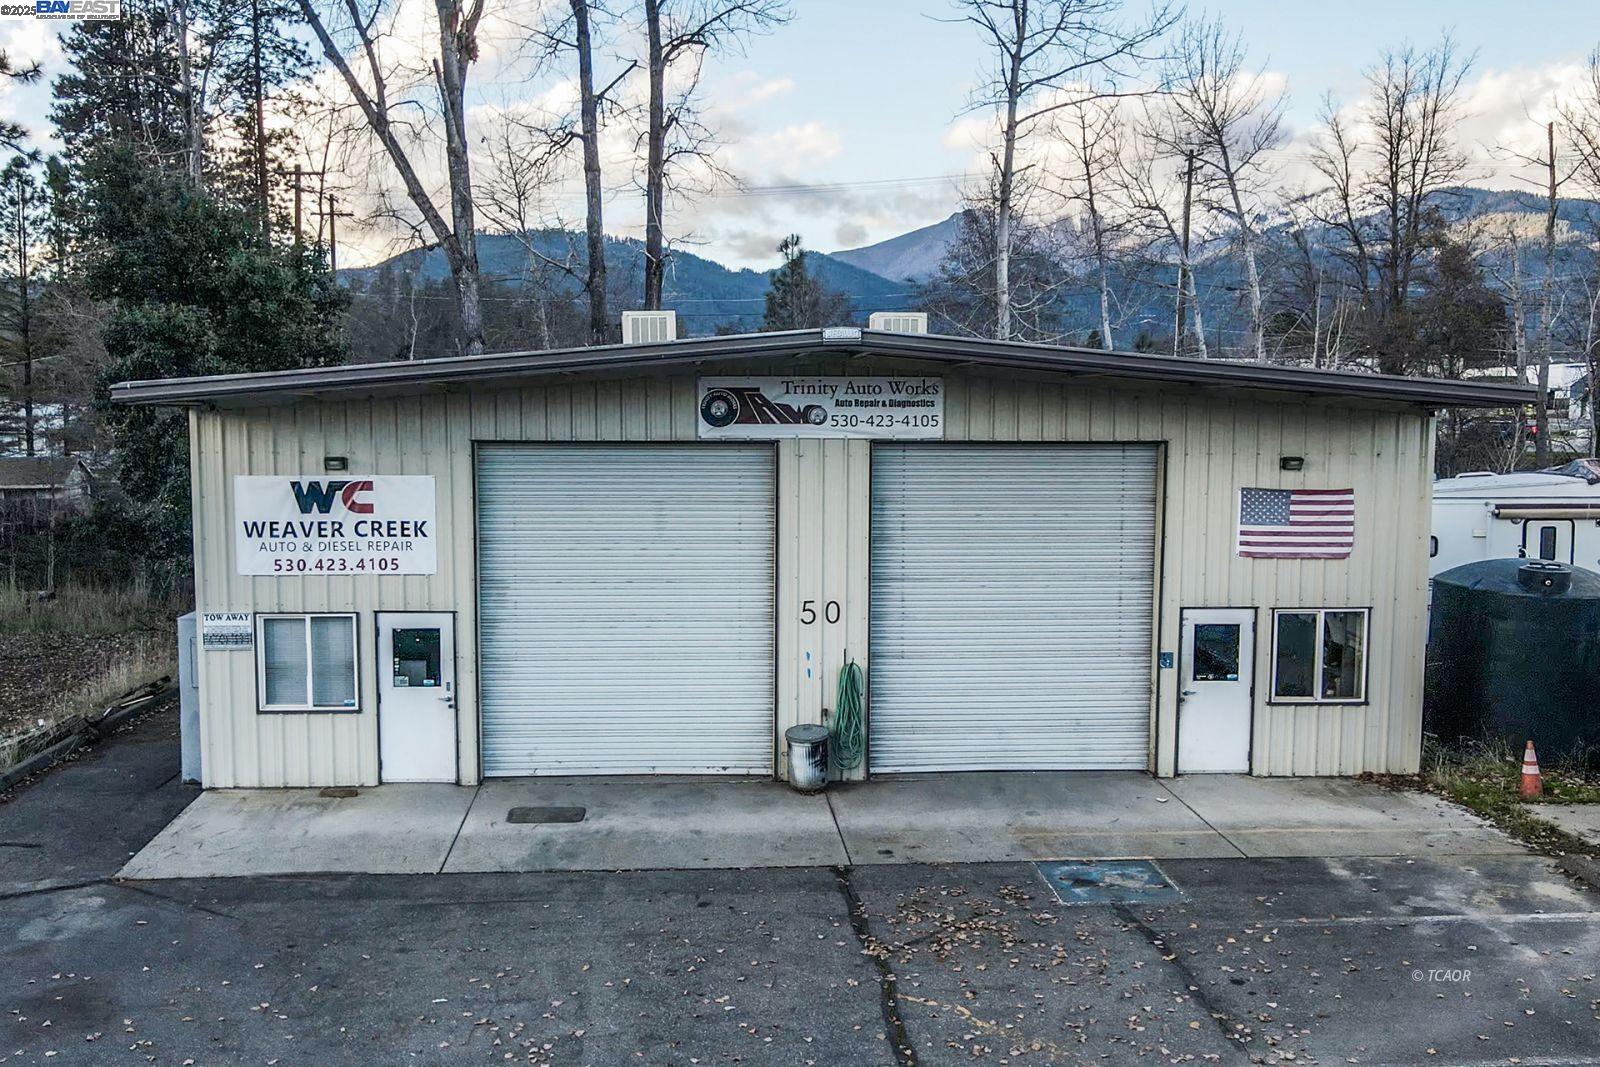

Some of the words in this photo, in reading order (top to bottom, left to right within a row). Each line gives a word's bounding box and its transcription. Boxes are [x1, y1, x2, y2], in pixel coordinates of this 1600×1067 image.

[781, 379, 838, 399] Trinity
[844, 380, 882, 395] Auto
[887, 379, 939, 395] Works
[834, 398, 853, 408] Auto
[854, 398, 880, 409] Repair
[881, 399, 887, 408] &
[888, 398, 936, 409] Diagnostics
[830, 414, 939, 427] 530-423-4105
[243, 520, 345, 538] WEAVER
[354, 520, 428, 538] CREEK
[259, 541, 297, 552] AUTO
[303, 541, 313, 552] &
[318, 541, 362, 551] DIESEL
[368, 540, 413, 551] REPAIR
[274, 557, 399, 572] 530.423.4105
[800, 600, 841, 625] 50
